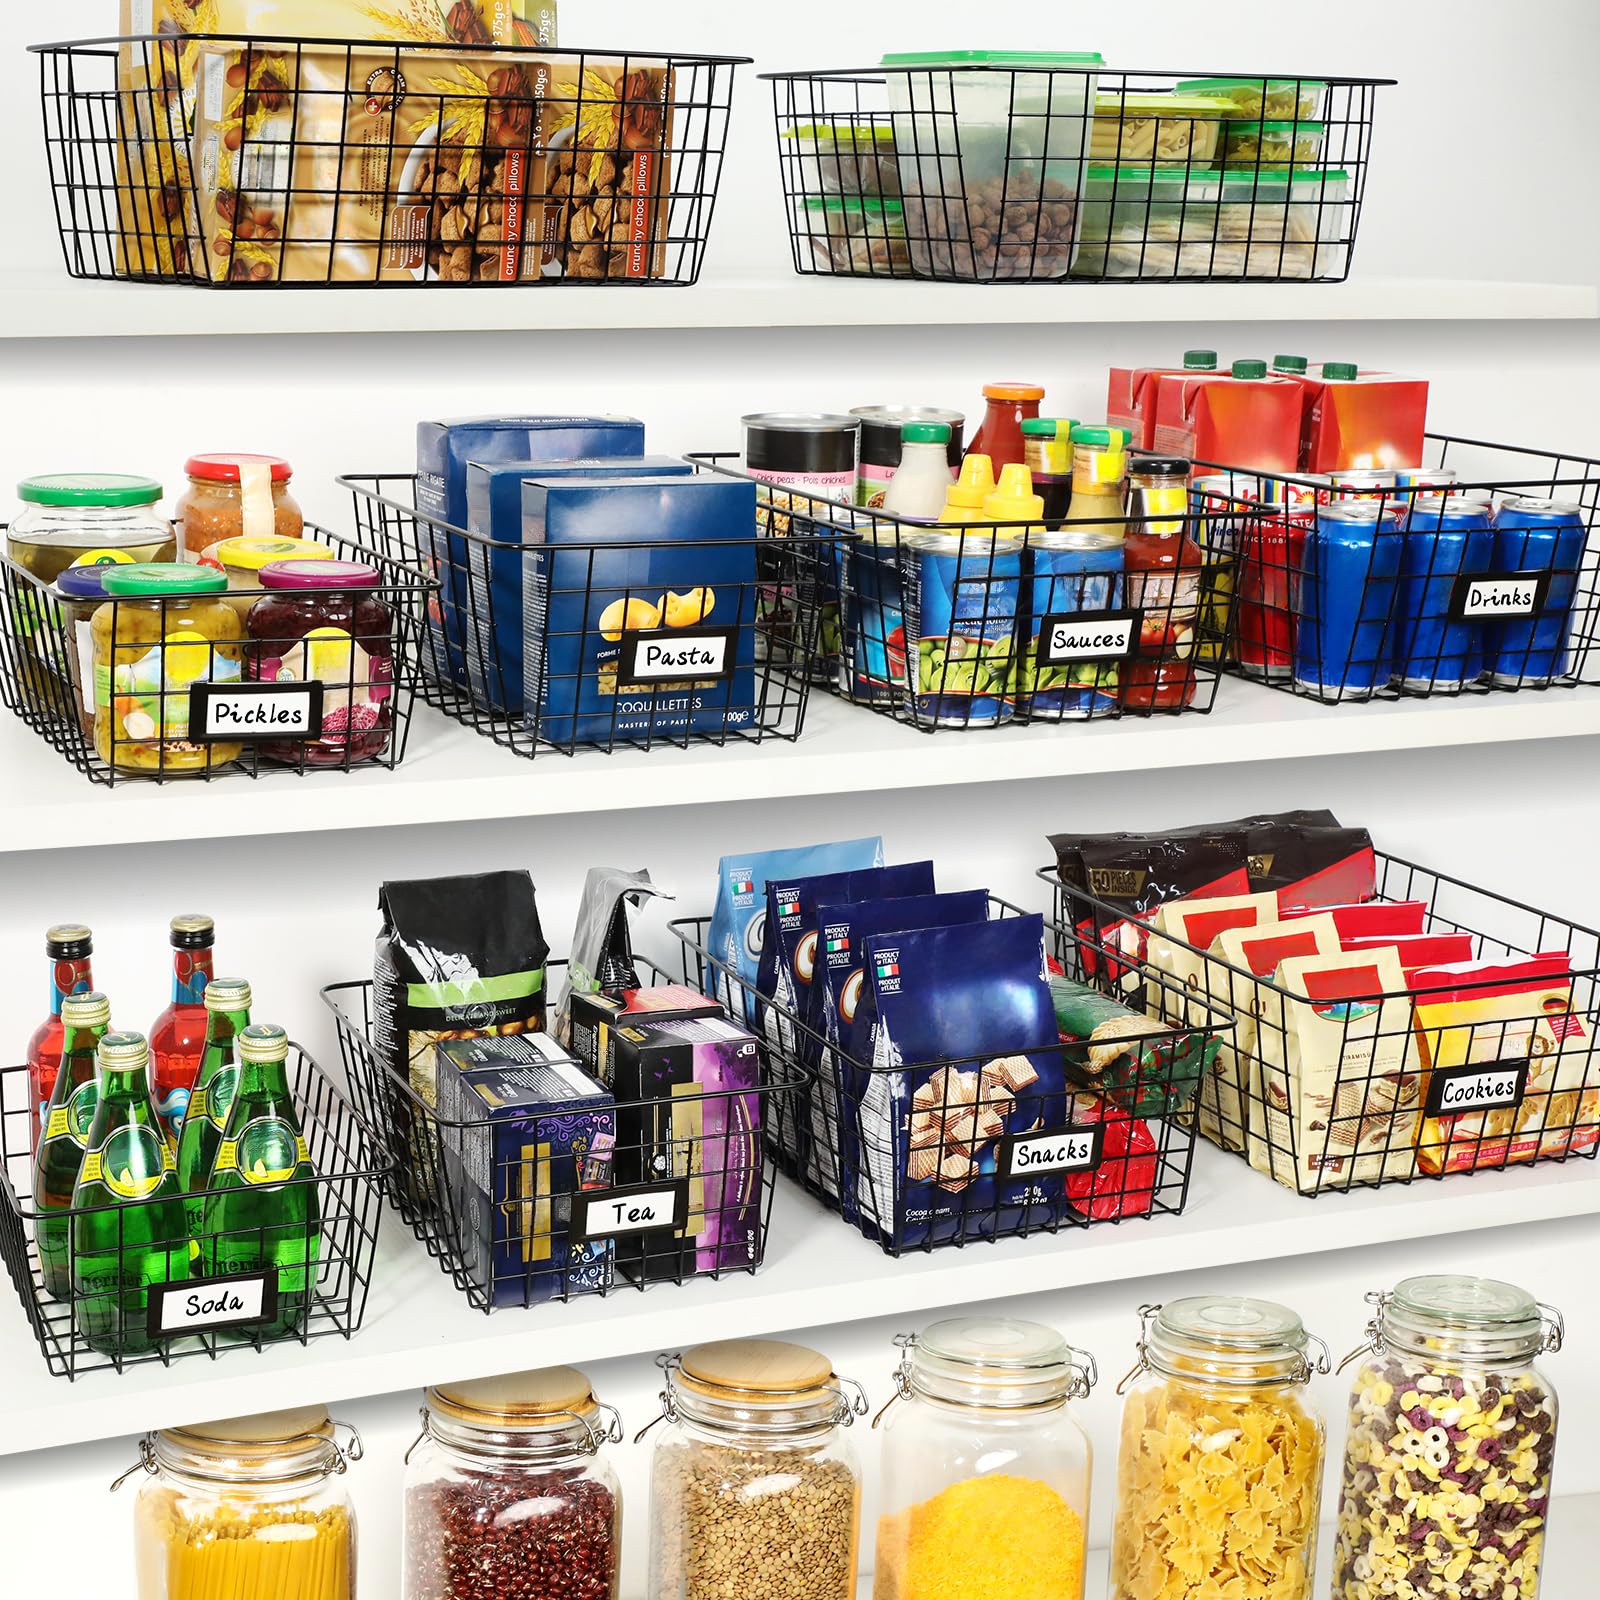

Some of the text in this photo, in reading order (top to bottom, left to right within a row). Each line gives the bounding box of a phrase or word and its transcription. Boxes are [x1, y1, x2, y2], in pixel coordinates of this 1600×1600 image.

[509, 152, 520, 191] pillows
[636, 154, 648, 192] pillows
[776, 475, 795, 485] peas
[1470, 587, 1532, 607] Drinks
[1053, 629, 1125, 650] Sauces
[647, 645, 715, 666] Pasta
[617, 697, 702, 713] COQULLETTS
[215, 702, 302, 724] Pickles
[618, 721, 650, 729] MASTER
[656, 719, 667, 727] OF
[729, 871, 753, 879] PRODUCT
[1092, 870, 1137, 892] 50 PIECES
[776, 890, 800, 899] PRODUCT
[1111, 884, 1137, 893] INSIDE
[779, 915, 801, 924] PRODUIT
[825, 926, 850, 935] PRODUCT
[826, 952, 851, 960] PRODUIT
[873, 951, 900, 960] PRODUCT
[882, 957, 898, 965] ITALY
[878, 977, 901, 987] PRODUIT
[495, 1007, 517, 1016] SWEET
[869, 1022, 877, 1042] CANADA
[1443, 1077, 1514, 1103] Cookies
[1017, 1138, 1088, 1167] Snacks
[611, 1203, 656, 1225] Tea
[905, 1207, 951, 1216] Cocoa ceam
[185, 1291, 244, 1317] Soda
